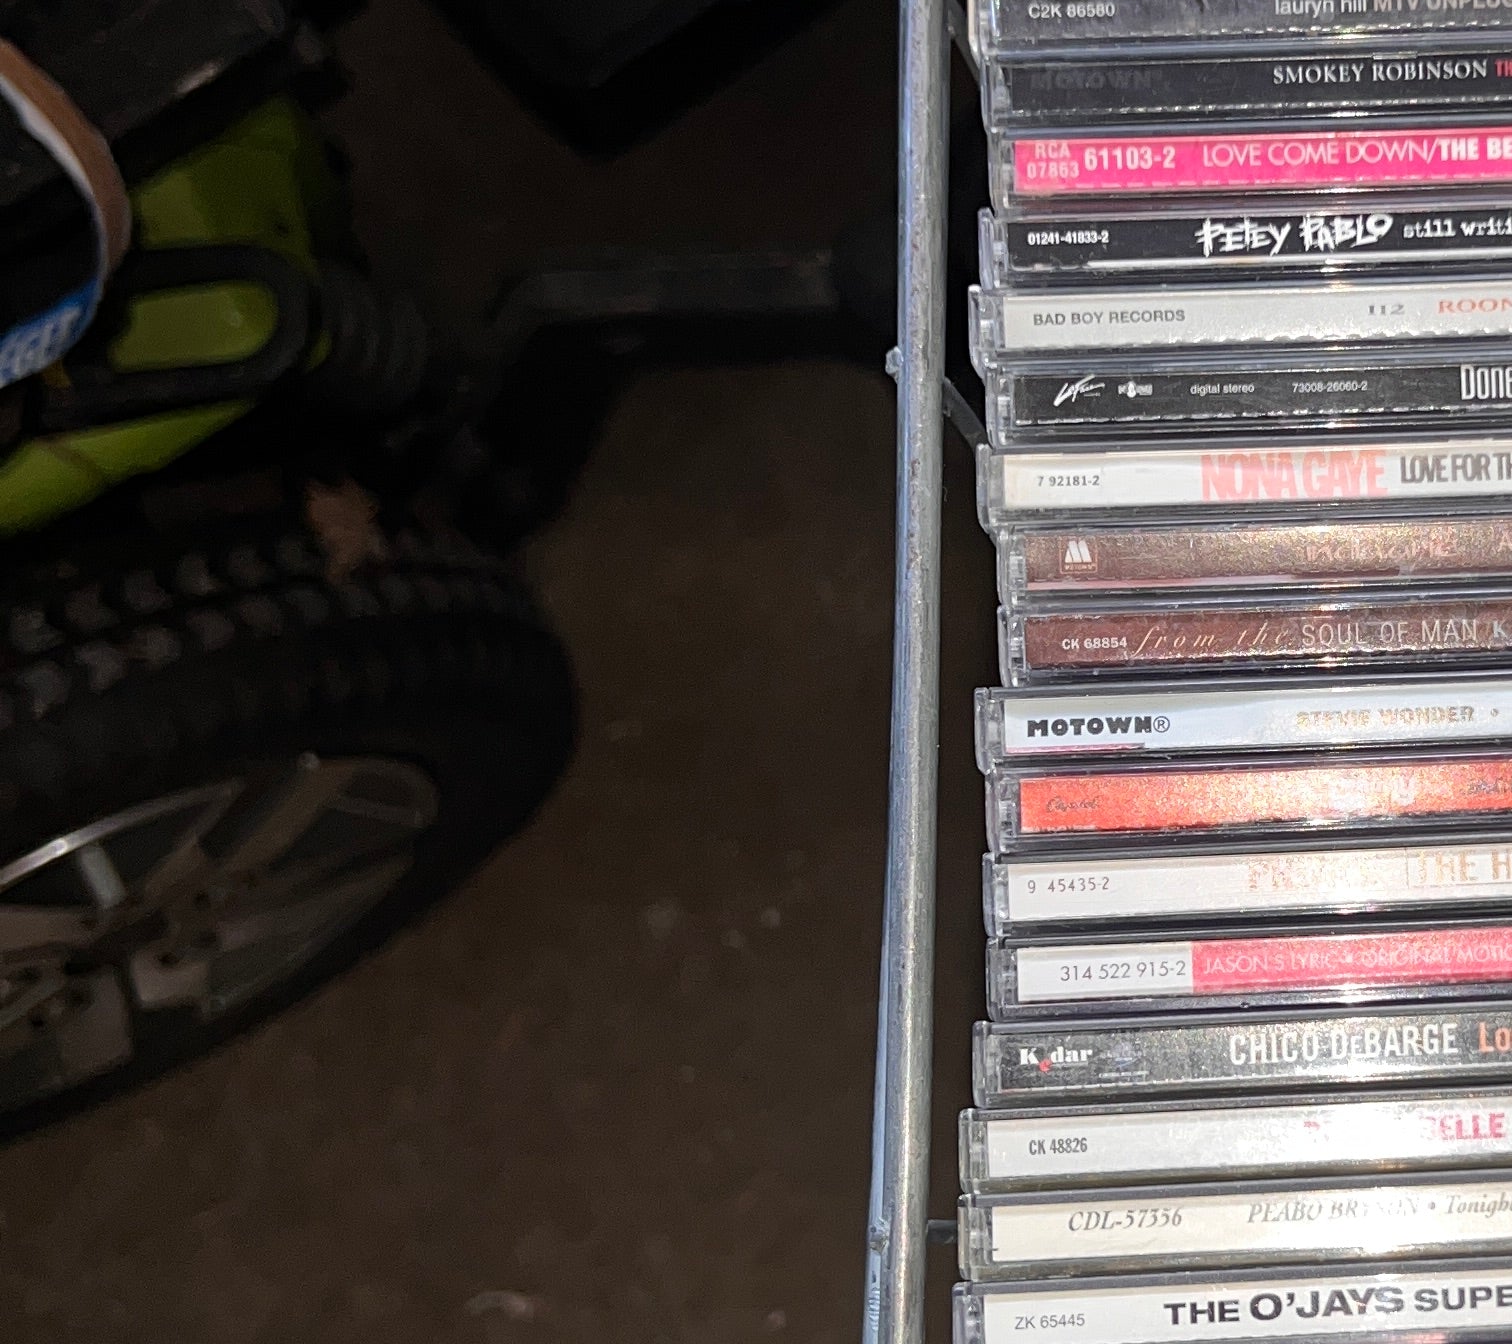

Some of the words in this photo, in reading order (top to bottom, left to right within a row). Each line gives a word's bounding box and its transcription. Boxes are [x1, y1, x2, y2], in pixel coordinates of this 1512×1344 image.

[1273, 64, 1364, 85] SMOKEY
[1372, 58, 1488, 81] ROBINSON
[1033, 311, 1066, 326] BAD
[1071, 310, 1104, 325] BOY
[1109, 308, 1186, 324] RECORDS
[1201, 453, 1299, 501] NONA
[1302, 449, 1389, 499] GAYE
[1400, 455, 1449, 485] LOVE
[1451, 452, 1490, 483] FOR
[1061, 637, 1080, 650] CK
[1083, 635, 1128, 650] 68854
[1124, 626, 1217, 660] from
[1234, 618, 1289, 647] the
[1302, 621, 1365, 646] SOUL
[1380, 621, 1408, 644] OF
[1421, 619, 1477, 641] MAN
[1060, 965, 1092, 982] 314
[1099, 963, 1133, 980] 522
[1136, 960, 1186, 978] 915-2
[1067, 1207, 1184, 1233] CDL-57356
[1014, 1315, 1036, 1330] ZK
[1040, 1313, 1085, 1328] 65445
